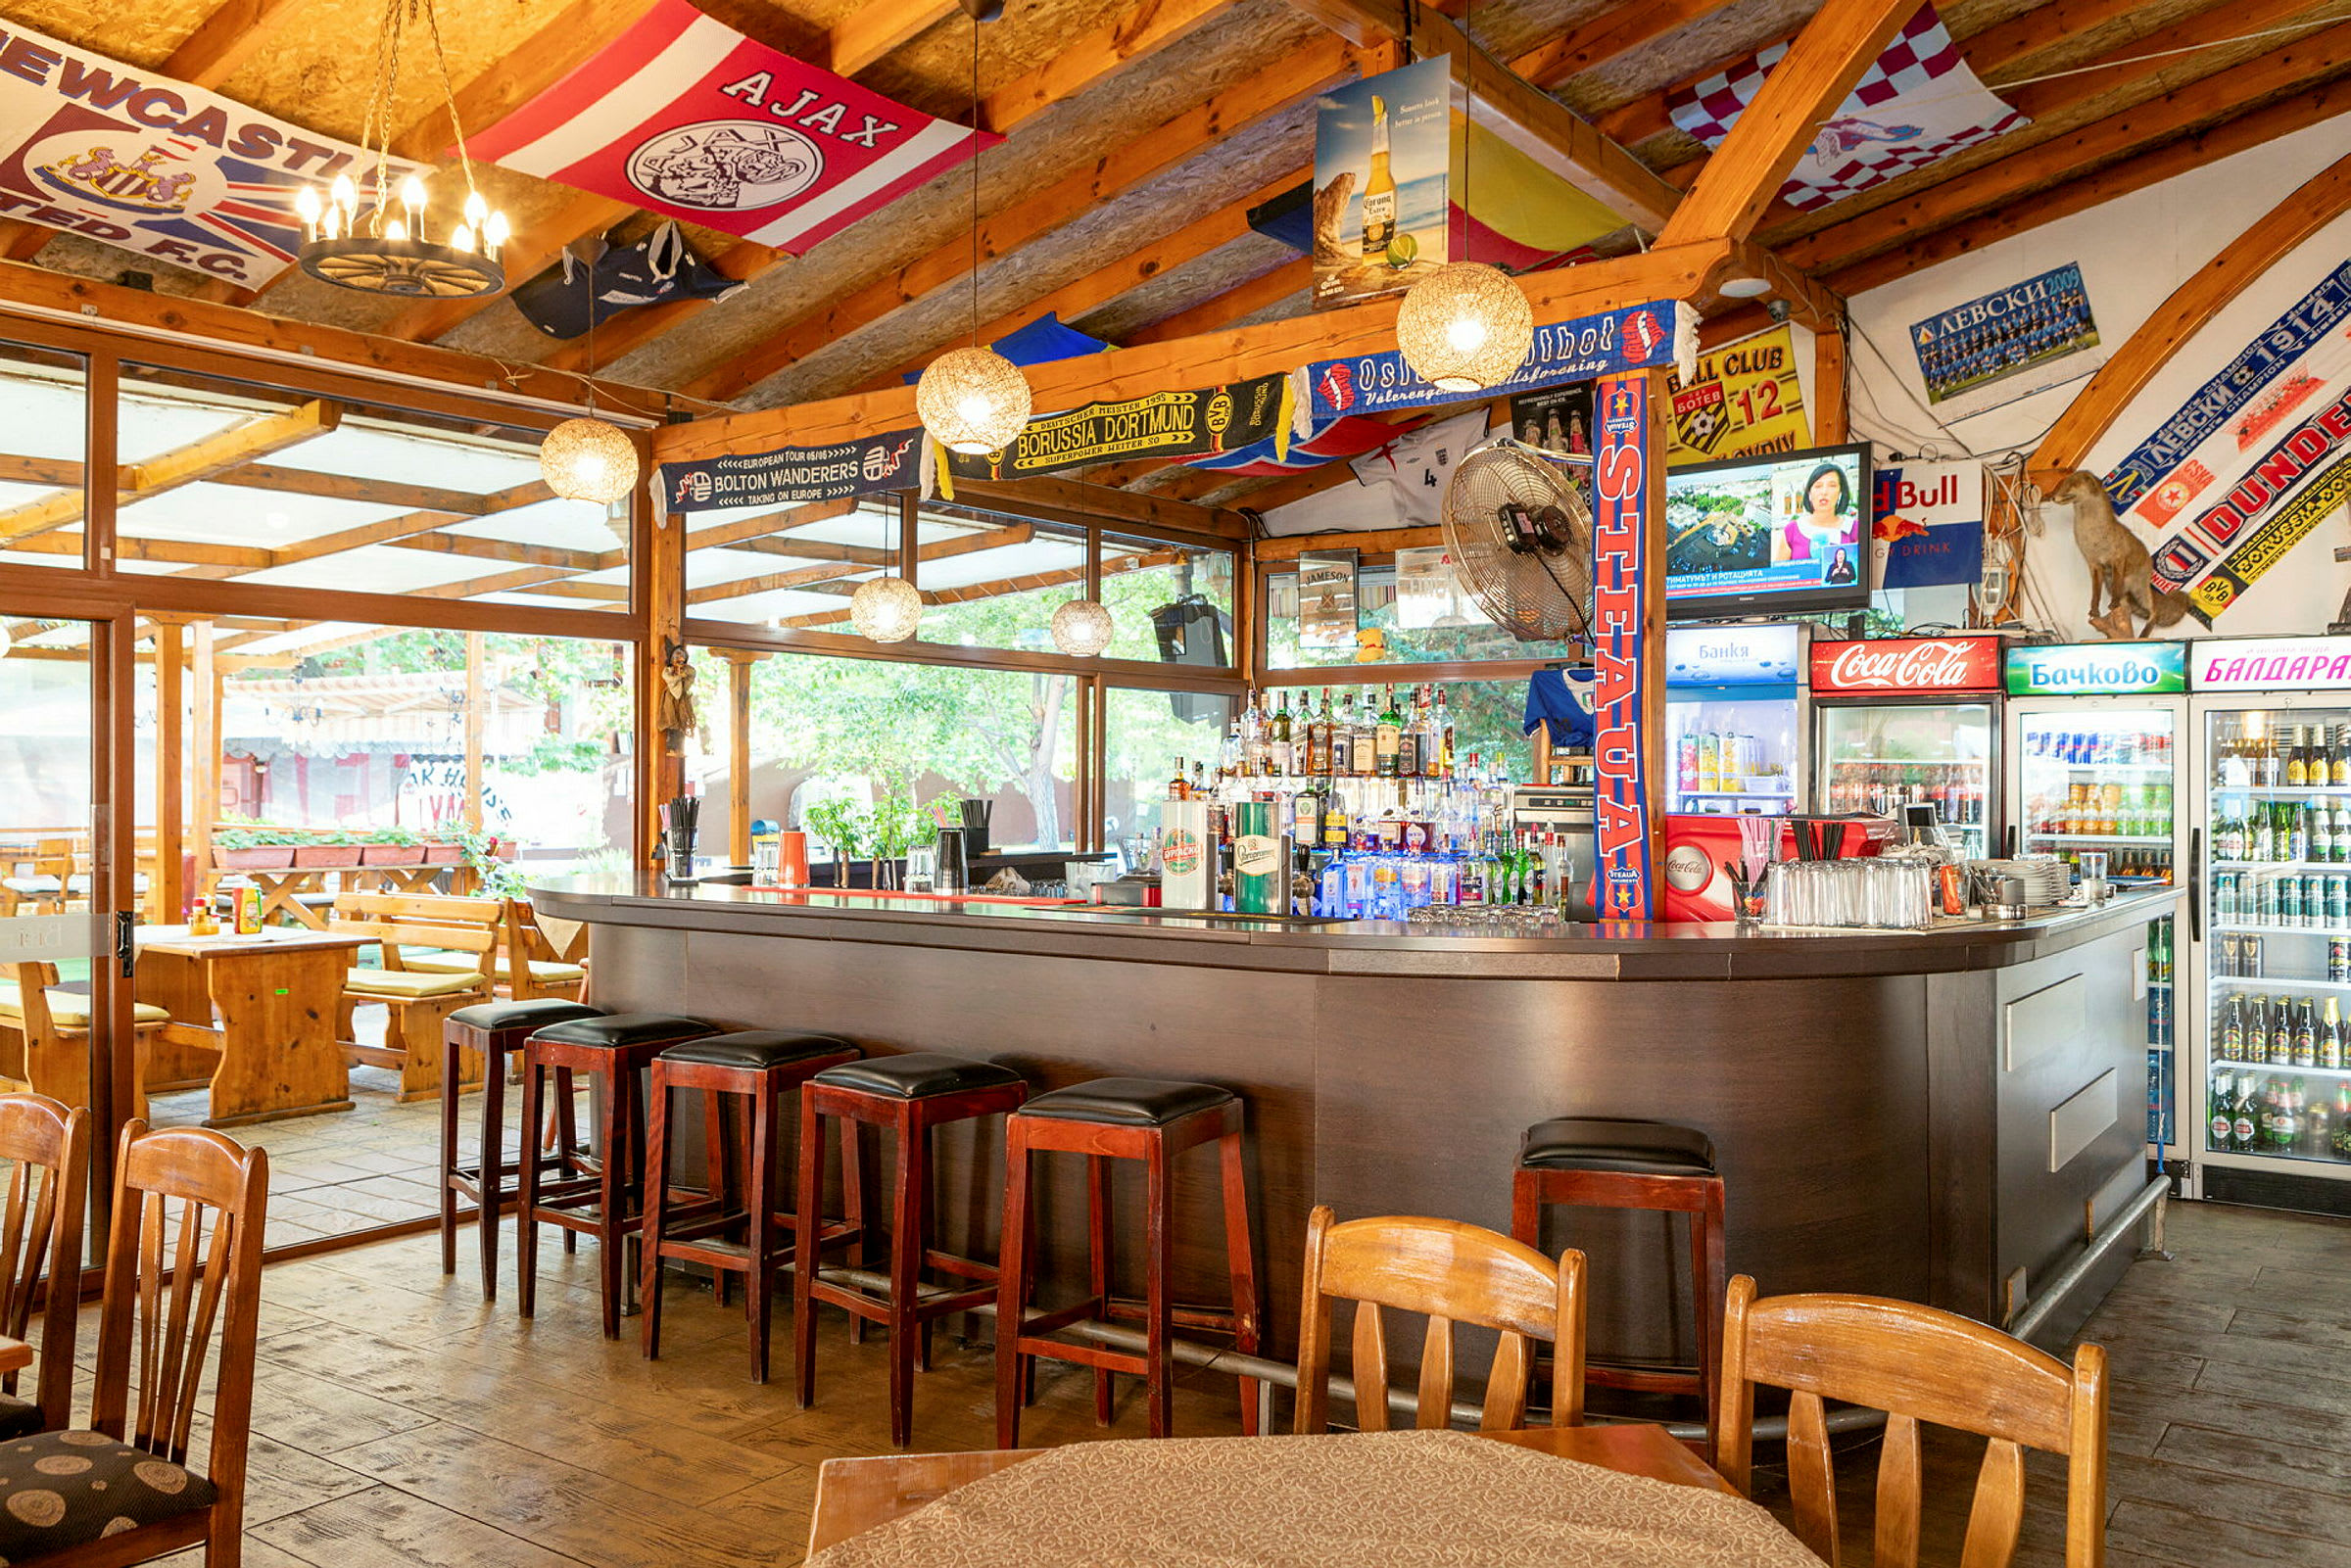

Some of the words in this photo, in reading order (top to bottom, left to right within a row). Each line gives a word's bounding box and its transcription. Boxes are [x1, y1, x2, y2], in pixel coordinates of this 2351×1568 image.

[721, 70, 901, 149] AJAX
[643, 128, 792, 173] AJAX
[1939, 280, 2046, 338] ЛЕВСКИ
[2045, 267, 2080, 295] 2009
[1666, 359, 1718, 395] BLL
[1724, 347, 1783, 376] CLUB
[2151, 384, 2234, 457] ЛЕВСКИ
[2256, 297, 2336, 363] 1914
[2203, 339, 2263, 395] CHAMPION
[2226, 357, 2286, 413] CHAMPION
[1099, 402, 1141, 414] MEISTER
[1146, 394, 1167, 405] 1995
[1208, 400, 1227, 426] BVB
[1677, 391, 1722, 413] БОТЕВ
[1737, 379, 1784, 426] 12
[1018, 419, 1098, 458] BORUSSIA
[1104, 404, 1196, 443] DORTMUND
[1108, 440, 1143, 451] WEITER
[1147, 437, 1161, 446] SO
[744, 453, 785, 469] EUROPEAN
[785, 451, 806, 462] TOUR
[2183, 458, 2217, 485] CSKA
[715, 472, 767, 493] BOLTON
[770, 460, 859, 488] WANDERERS
[1424, 468, 1438, 488] 4
[747, 494, 775, 505] TAKING
[777, 491, 790, 501] ON
[792, 489, 823, 500] EUROPE
[1895, 474, 1958, 509] Bull
[1901, 542, 1951, 556] DRINK
[2234, 500, 2321, 574] BORUSSIA
[1305, 571, 1350, 587] JAMESON
[2204, 581, 2230, 602] BVB
[1596, 445, 1643, 858] STEAUA
[1699, 642, 1749, 659] Банкя
[1831, 641, 1977, 687] Coca-Cola
[2032, 661, 2159, 687] Бачково
[2204, 654, 2351, 683] БАЛДАРА
[1667, 859, 1703, 874] Coca-Cola
